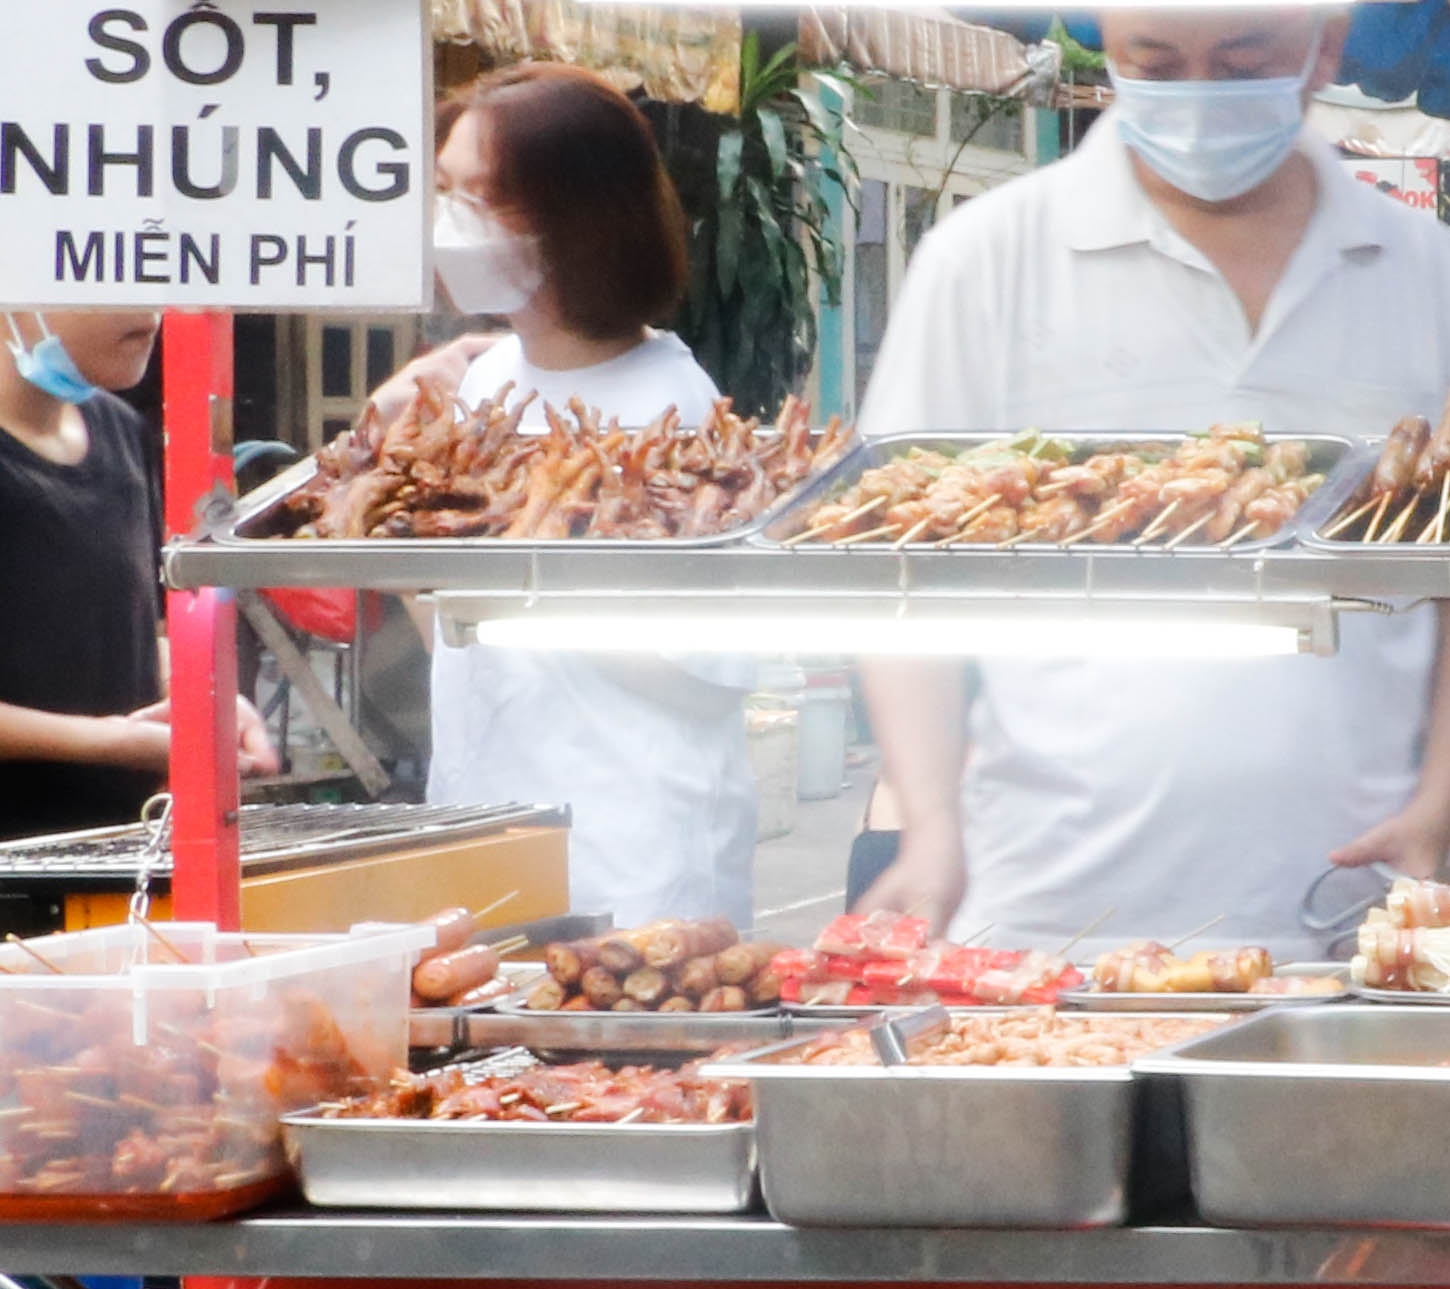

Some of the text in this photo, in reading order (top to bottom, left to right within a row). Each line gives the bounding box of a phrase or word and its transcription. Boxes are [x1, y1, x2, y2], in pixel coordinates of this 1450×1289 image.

[1, 104, 411, 202] NHÚNG
[54, 218, 357, 287] MIỄN PHÍ
